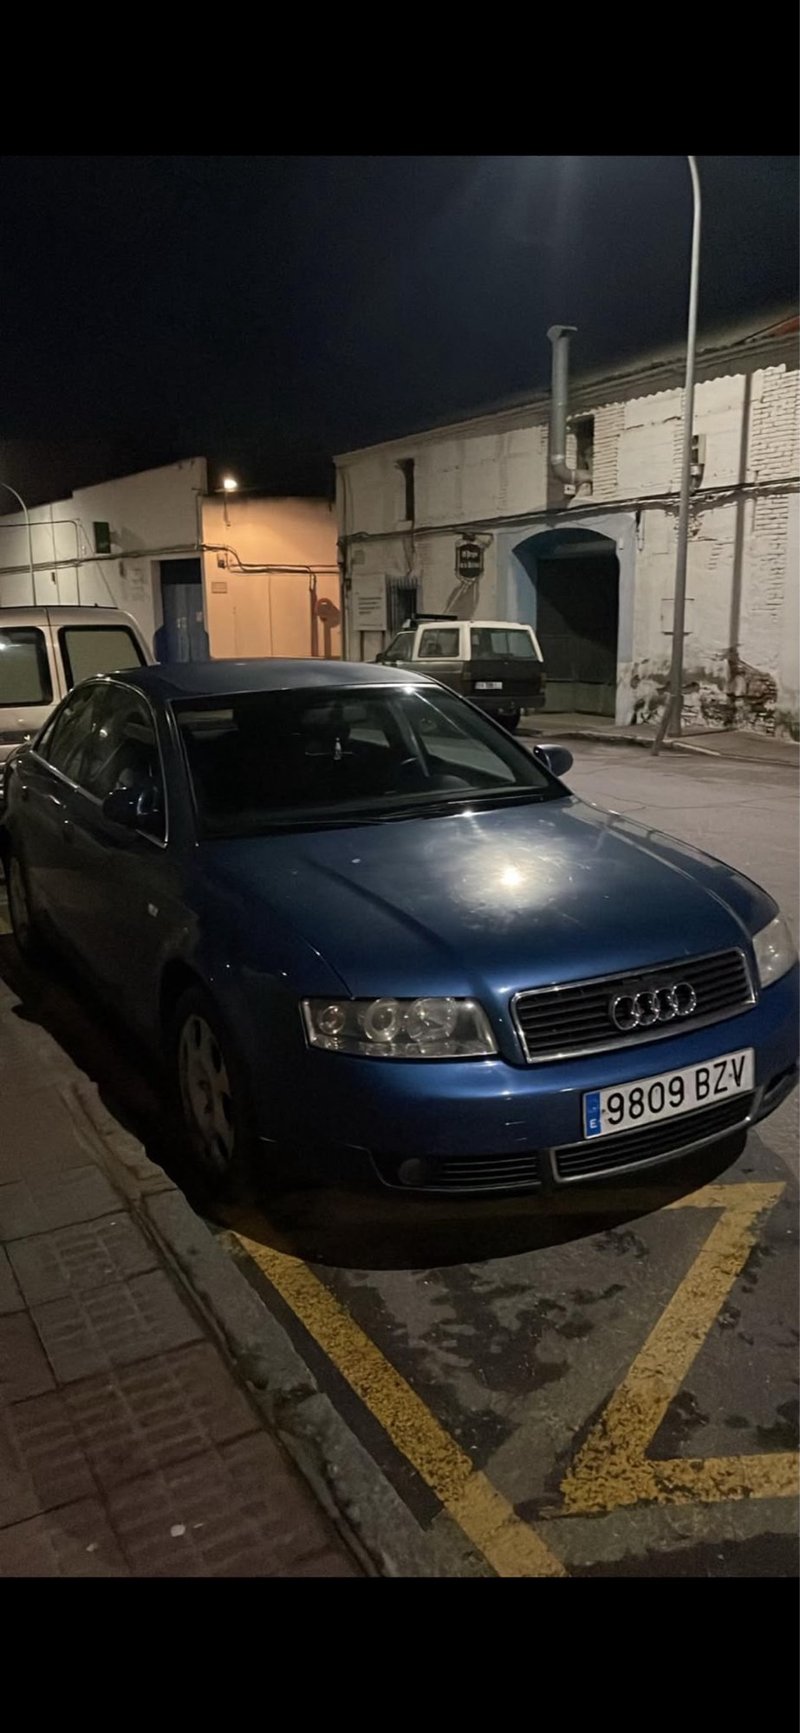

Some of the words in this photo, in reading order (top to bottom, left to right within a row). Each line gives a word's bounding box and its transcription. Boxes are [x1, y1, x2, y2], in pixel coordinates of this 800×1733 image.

[607, 1076, 684, 1125] 9809
[695, 1055, 746, 1101] BZV
[590, 1118, 598, 1129] E
